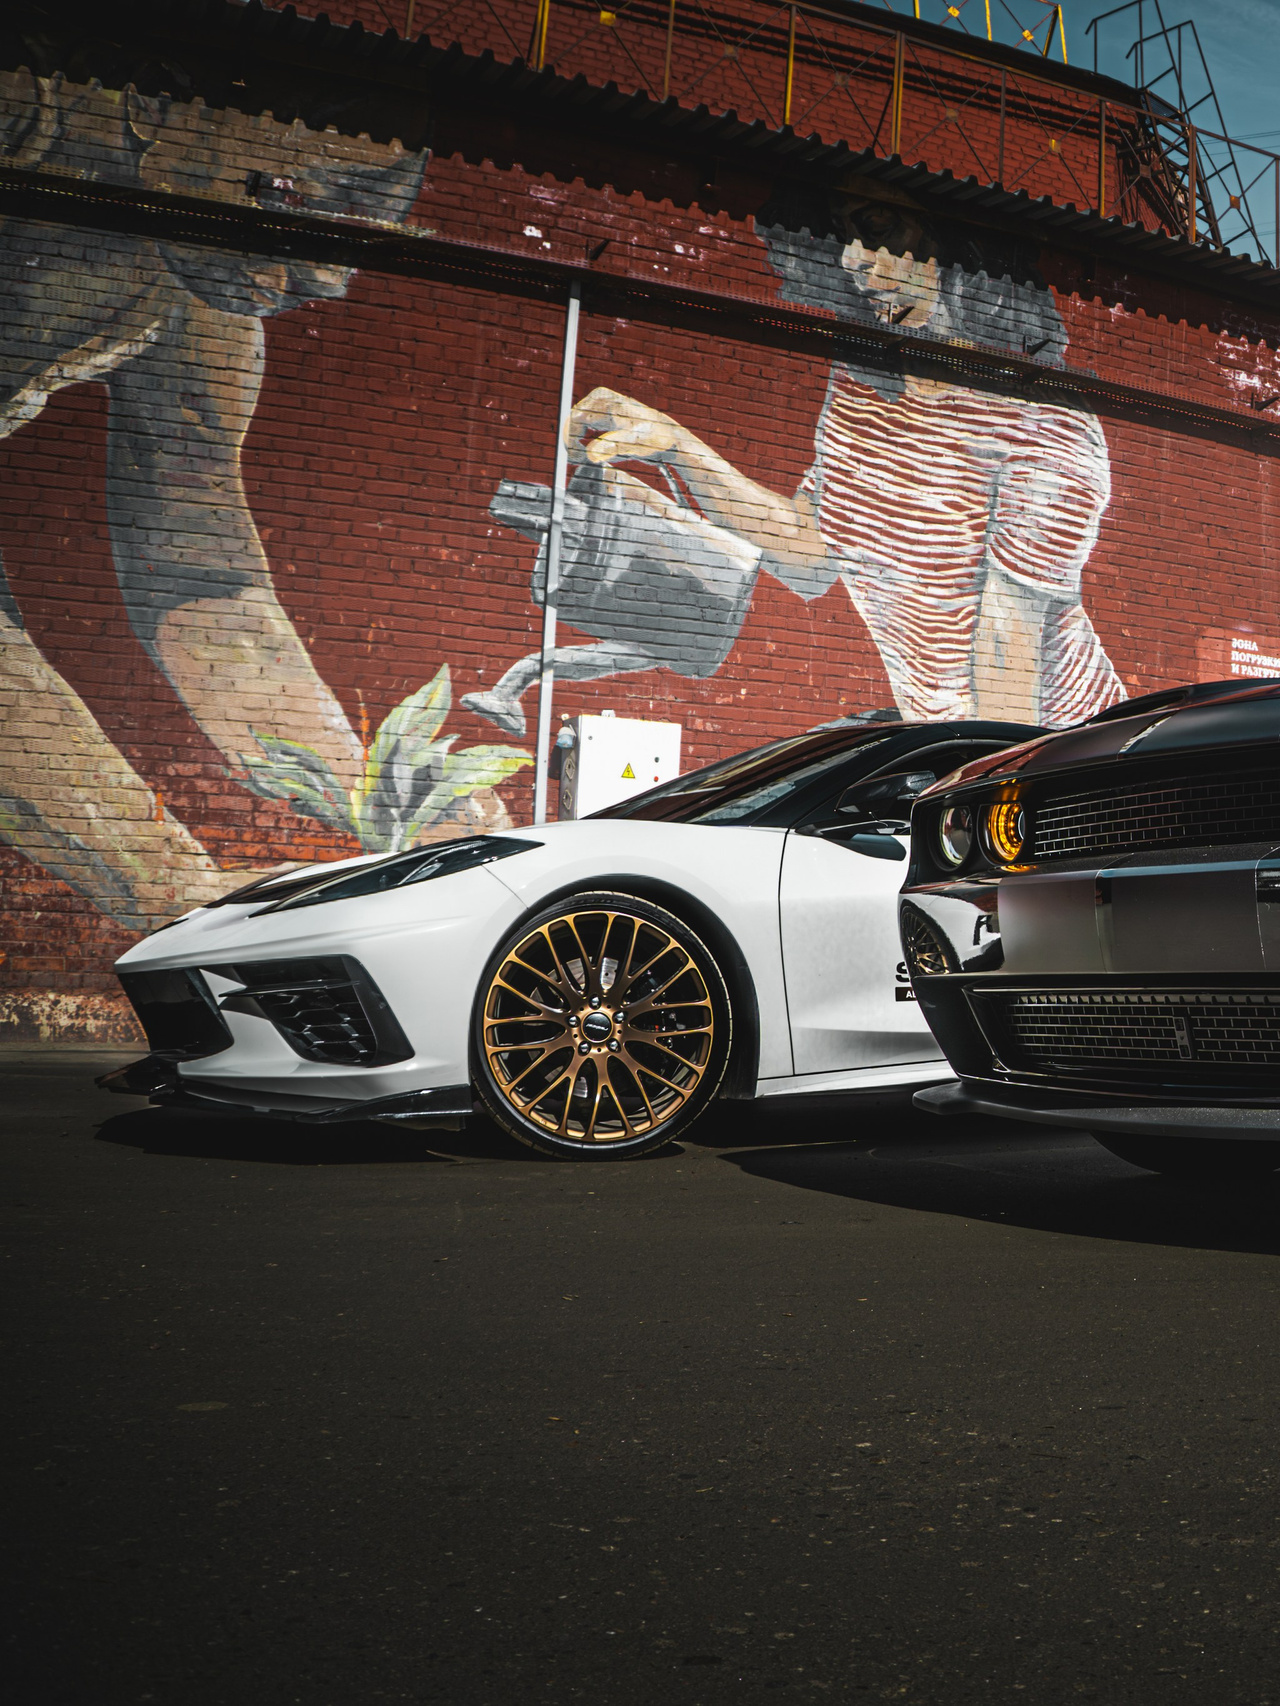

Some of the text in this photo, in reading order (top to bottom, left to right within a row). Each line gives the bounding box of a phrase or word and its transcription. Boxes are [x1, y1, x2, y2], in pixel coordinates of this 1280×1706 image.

[1231, 637, 1259, 651] ЗОНА
[1231, 651, 1280, 668] ПОГРУЗКИ
[1231, 663, 1240, 674] И
